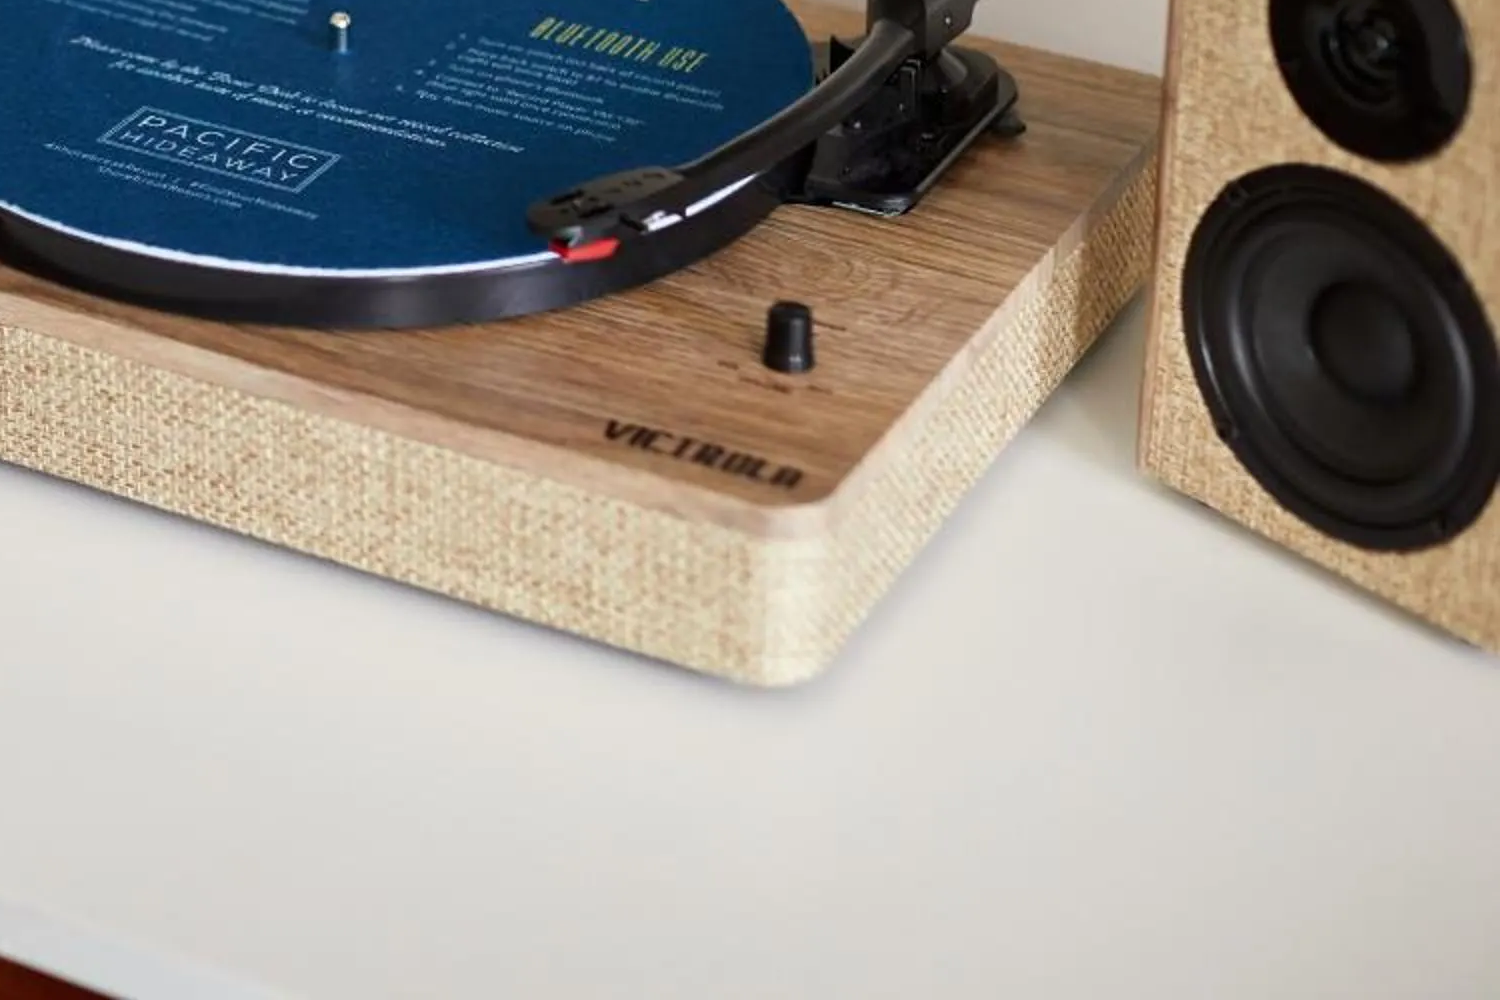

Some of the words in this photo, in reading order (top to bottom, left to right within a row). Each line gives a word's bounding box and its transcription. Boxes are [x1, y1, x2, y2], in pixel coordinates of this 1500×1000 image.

[529, 17, 661, 62] BLUETOOTH
[657, 47, 708, 72] USE
[118, 130, 298, 182] HIDEAWAY
[138, 114, 318, 169] PACIFIC
[604, 419, 804, 490] VICTROLA
